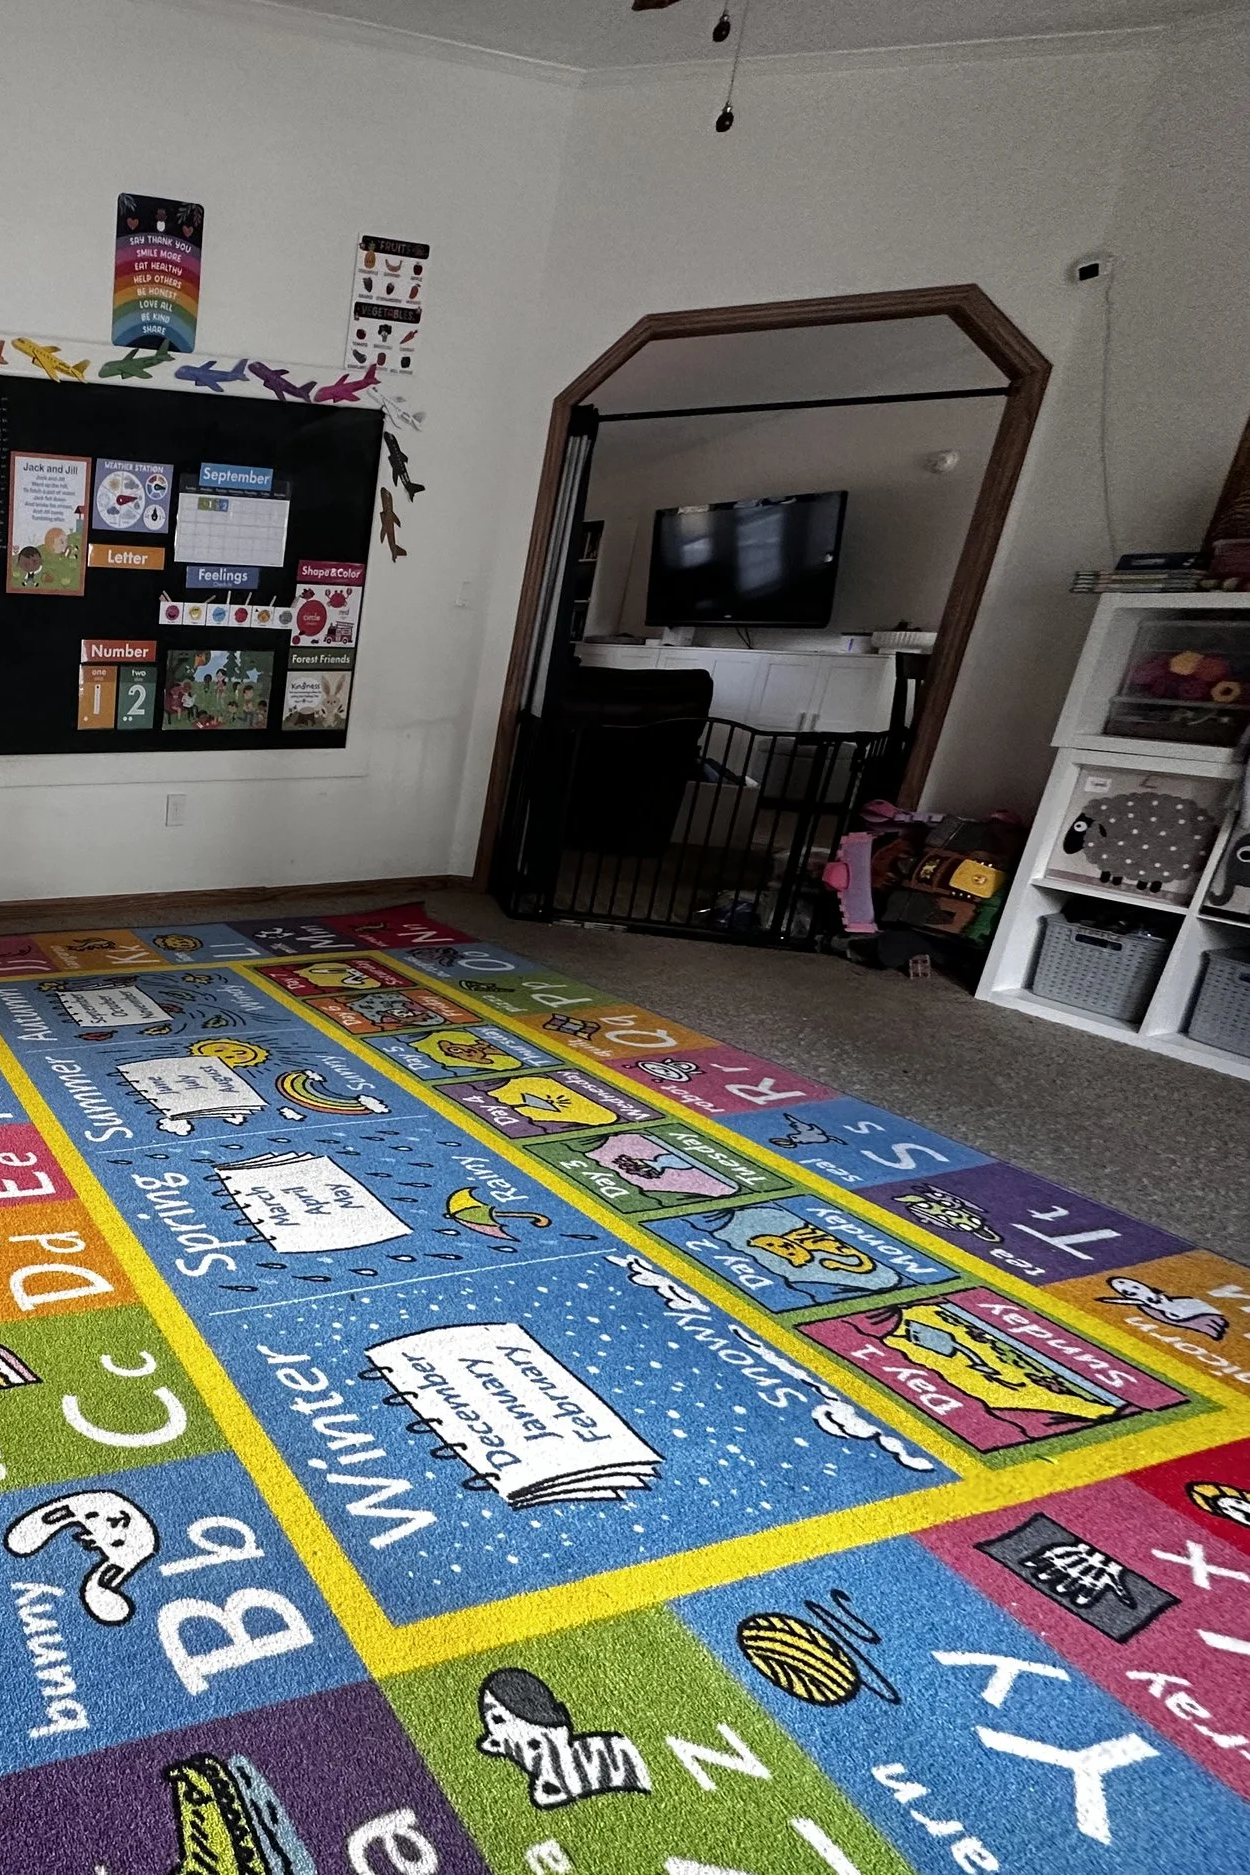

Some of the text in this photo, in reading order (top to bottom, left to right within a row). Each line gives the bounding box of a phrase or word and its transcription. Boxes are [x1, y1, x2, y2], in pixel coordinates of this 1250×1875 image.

[129, 235, 192, 254] SAY THANK YOU
[136, 249, 182, 263] SMILE MORE
[133, 275, 182, 289] HELP OTHERS
[134, 261, 183, 276] EAT HEALTHY
[137, 287, 178, 300] BE HONEST
[139, 300, 173, 312] LOVE ALL
[141, 313, 170, 323] BE KIND
[361, 306, 415, 321] VEGETABLES
[142, 325, 166, 336] SHARE
[23, 462, 78, 475] Jack and Jill
[104, 461, 164, 473] WEATHER STATION
[203, 466, 271, 485] September
[107, 549, 148, 565] Letter
[302, 565, 361, 579] Shape&Color
[198, 567, 248, 584] Feelings
[91, 643, 149, 658] Number
[292, 654, 350, 664] Forest Friends
[131, 669, 147, 677] two
[291, 681, 320, 690] Kindness
[127, 684, 147, 716] 2
[336, 1011, 362, 1026] Day
[391, 1045, 432, 1073] Day 5
[477, 1025, 545, 1068] Thursday
[150, 1075, 180, 1096] June
[177, 1073, 204, 1091] July
[199, 1065, 240, 1094] August
[316, 1053, 376, 1092] Sunny
[44, 1055, 134, 1143] Summer
[462, 1095, 520, 1128] Day 4
[559, 1071, 652, 1121] Wednesday
[659, 1084, 727, 1115] robot
[668, 1131, 767, 1186] Tuesday
[799, 1156, 861, 1185] seal
[451, 1154, 529, 1203] Rainy
[559, 1159, 629, 1200] Day 3
[255, 1185, 301, 1229] March
[284, 1186, 333, 1218] April
[321, 1180, 367, 1210] May
[133, 1172, 255, 1278] Spring
[806, 1206, 939, 1279] Monday
[8, 1230, 117, 1313] Dd
[686, 1239, 773, 1293] Day 2
[989, 1247, 1047, 1278] tea
[677, 1300, 808, 1410] Snowy
[978, 1301, 1139, 1389] Sunday
[1124, 1316, 1250, 1384] nicorn
[60, 1348, 190, 1448] Cc
[459, 1355, 568, 1441] January
[493, 1343, 610, 1445] February
[858, 1347, 971, 1418] Day 1
[405, 1350, 512, 1476] December
[255, 1343, 439, 1551] Winter
[157, 1513, 318, 1695] Bb
[9, 1580, 91, 1739] bunny
[1125, 1668, 1250, 1763] ray
[870, 1760, 1001, 1875] arn
